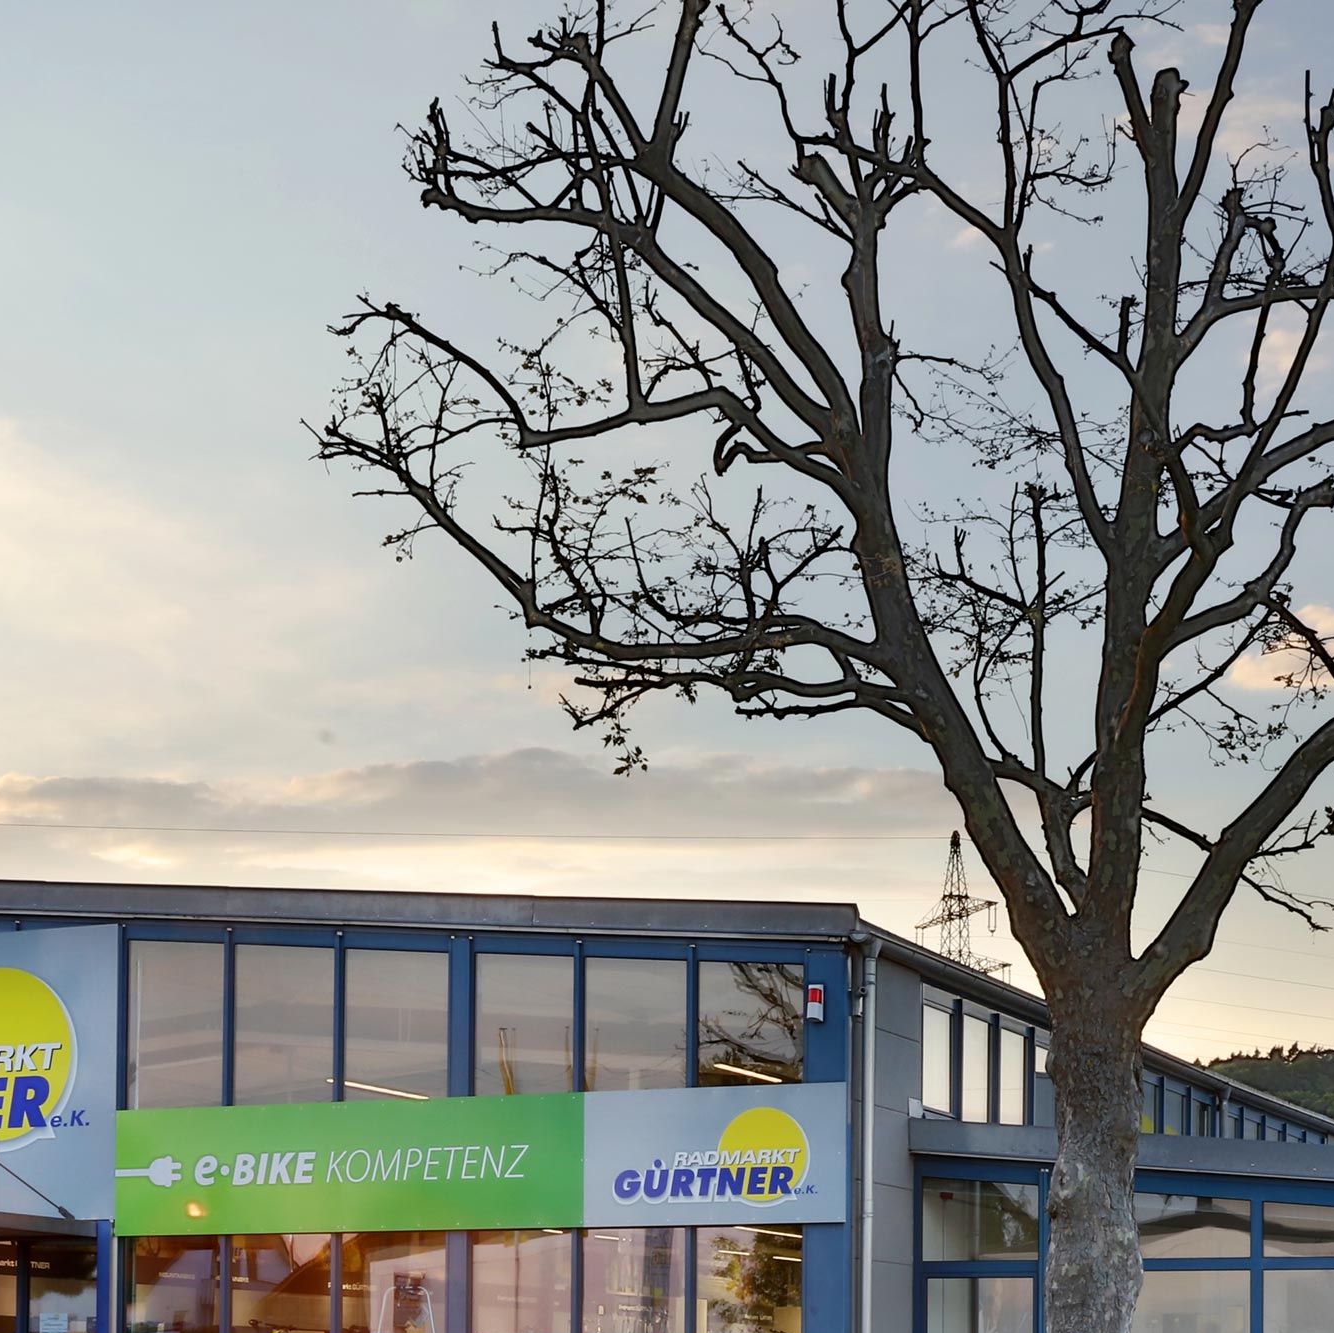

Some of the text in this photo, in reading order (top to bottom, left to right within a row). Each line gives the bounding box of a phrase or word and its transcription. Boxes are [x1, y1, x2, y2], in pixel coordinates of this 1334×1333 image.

[50, 1110, 90, 1128] e.K.
[326, 1144, 530, 1184] KOMPETENZ
[674, 1148, 801, 1168] RADMARKT
